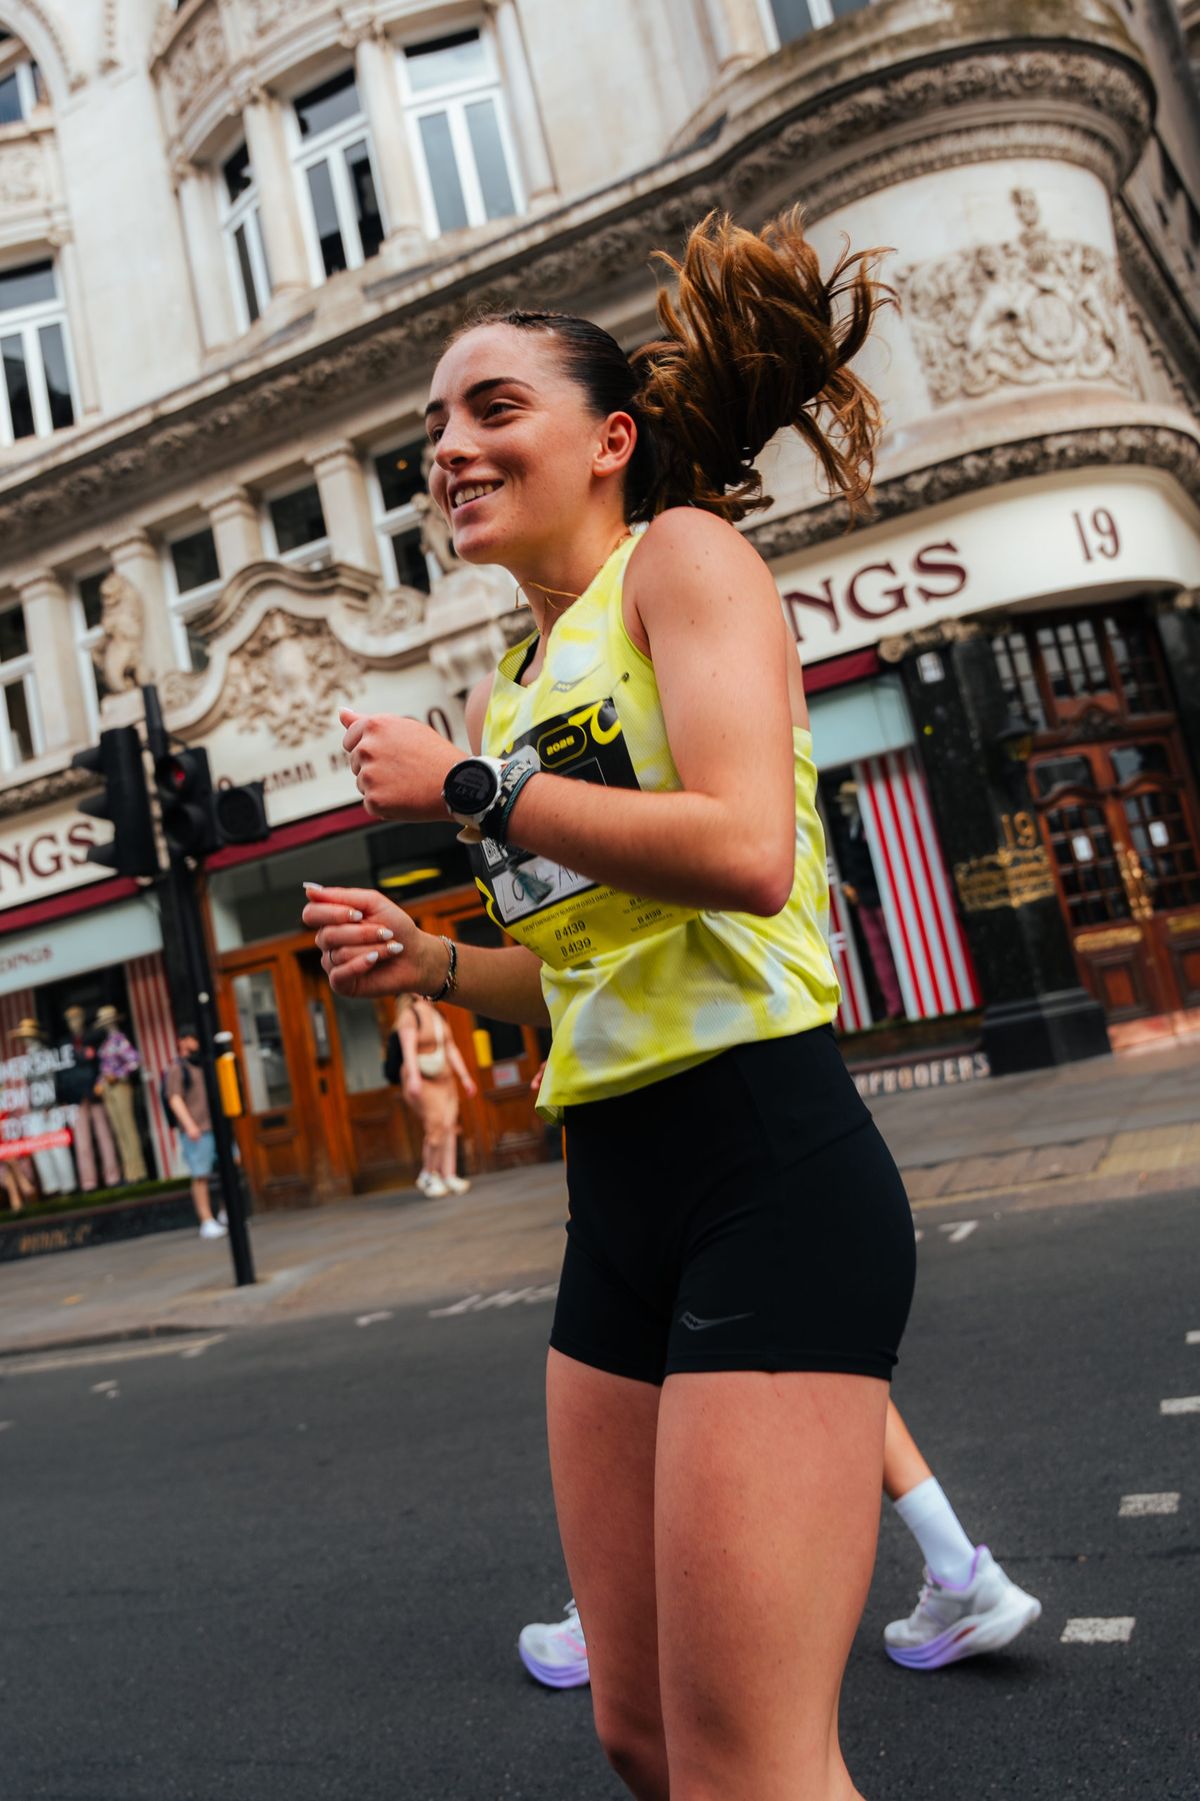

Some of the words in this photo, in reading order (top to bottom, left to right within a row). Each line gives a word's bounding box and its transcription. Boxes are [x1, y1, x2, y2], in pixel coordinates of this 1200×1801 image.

[1072, 507, 1121, 563] 19
[783, 541, 967, 642] NGS
[1001, 811, 1037, 849] 19
